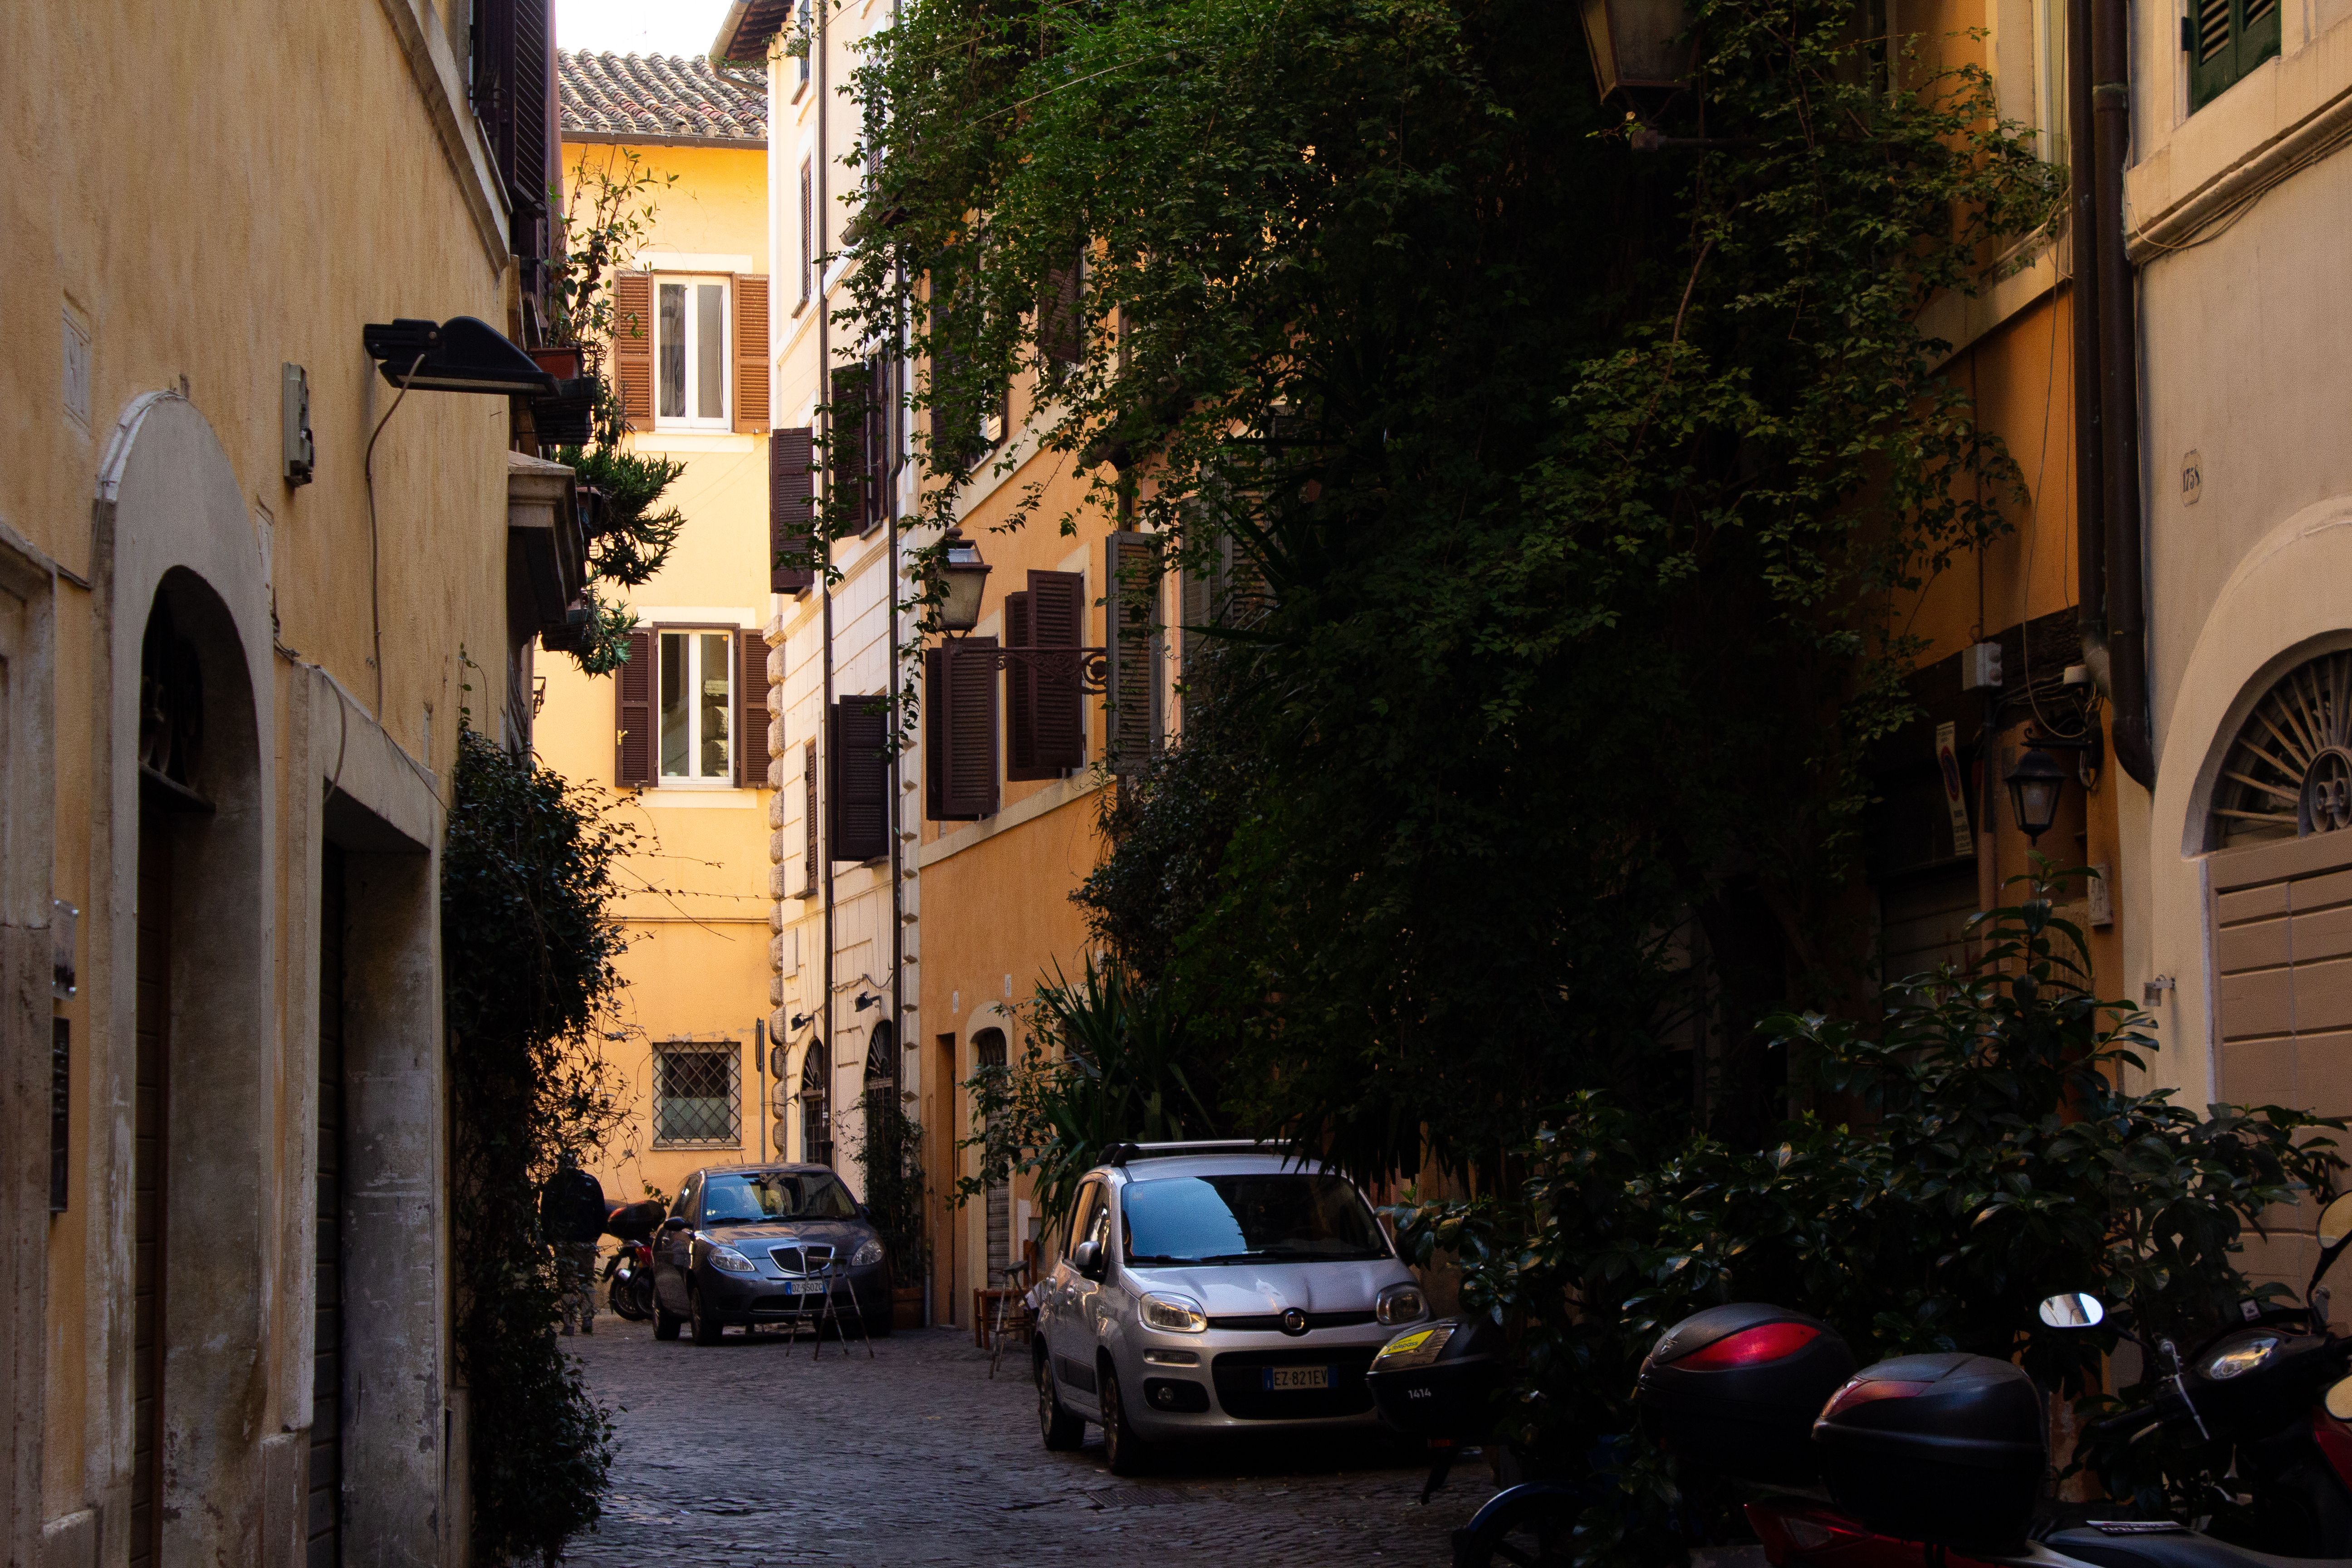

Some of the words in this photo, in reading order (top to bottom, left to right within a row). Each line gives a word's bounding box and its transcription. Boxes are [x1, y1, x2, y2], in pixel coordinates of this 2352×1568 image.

[1274, 1372, 1288, 1386] EZ
[1292, 1370, 1328, 1385] 821EV
[1408, 1388, 1431, 1399] 1414
